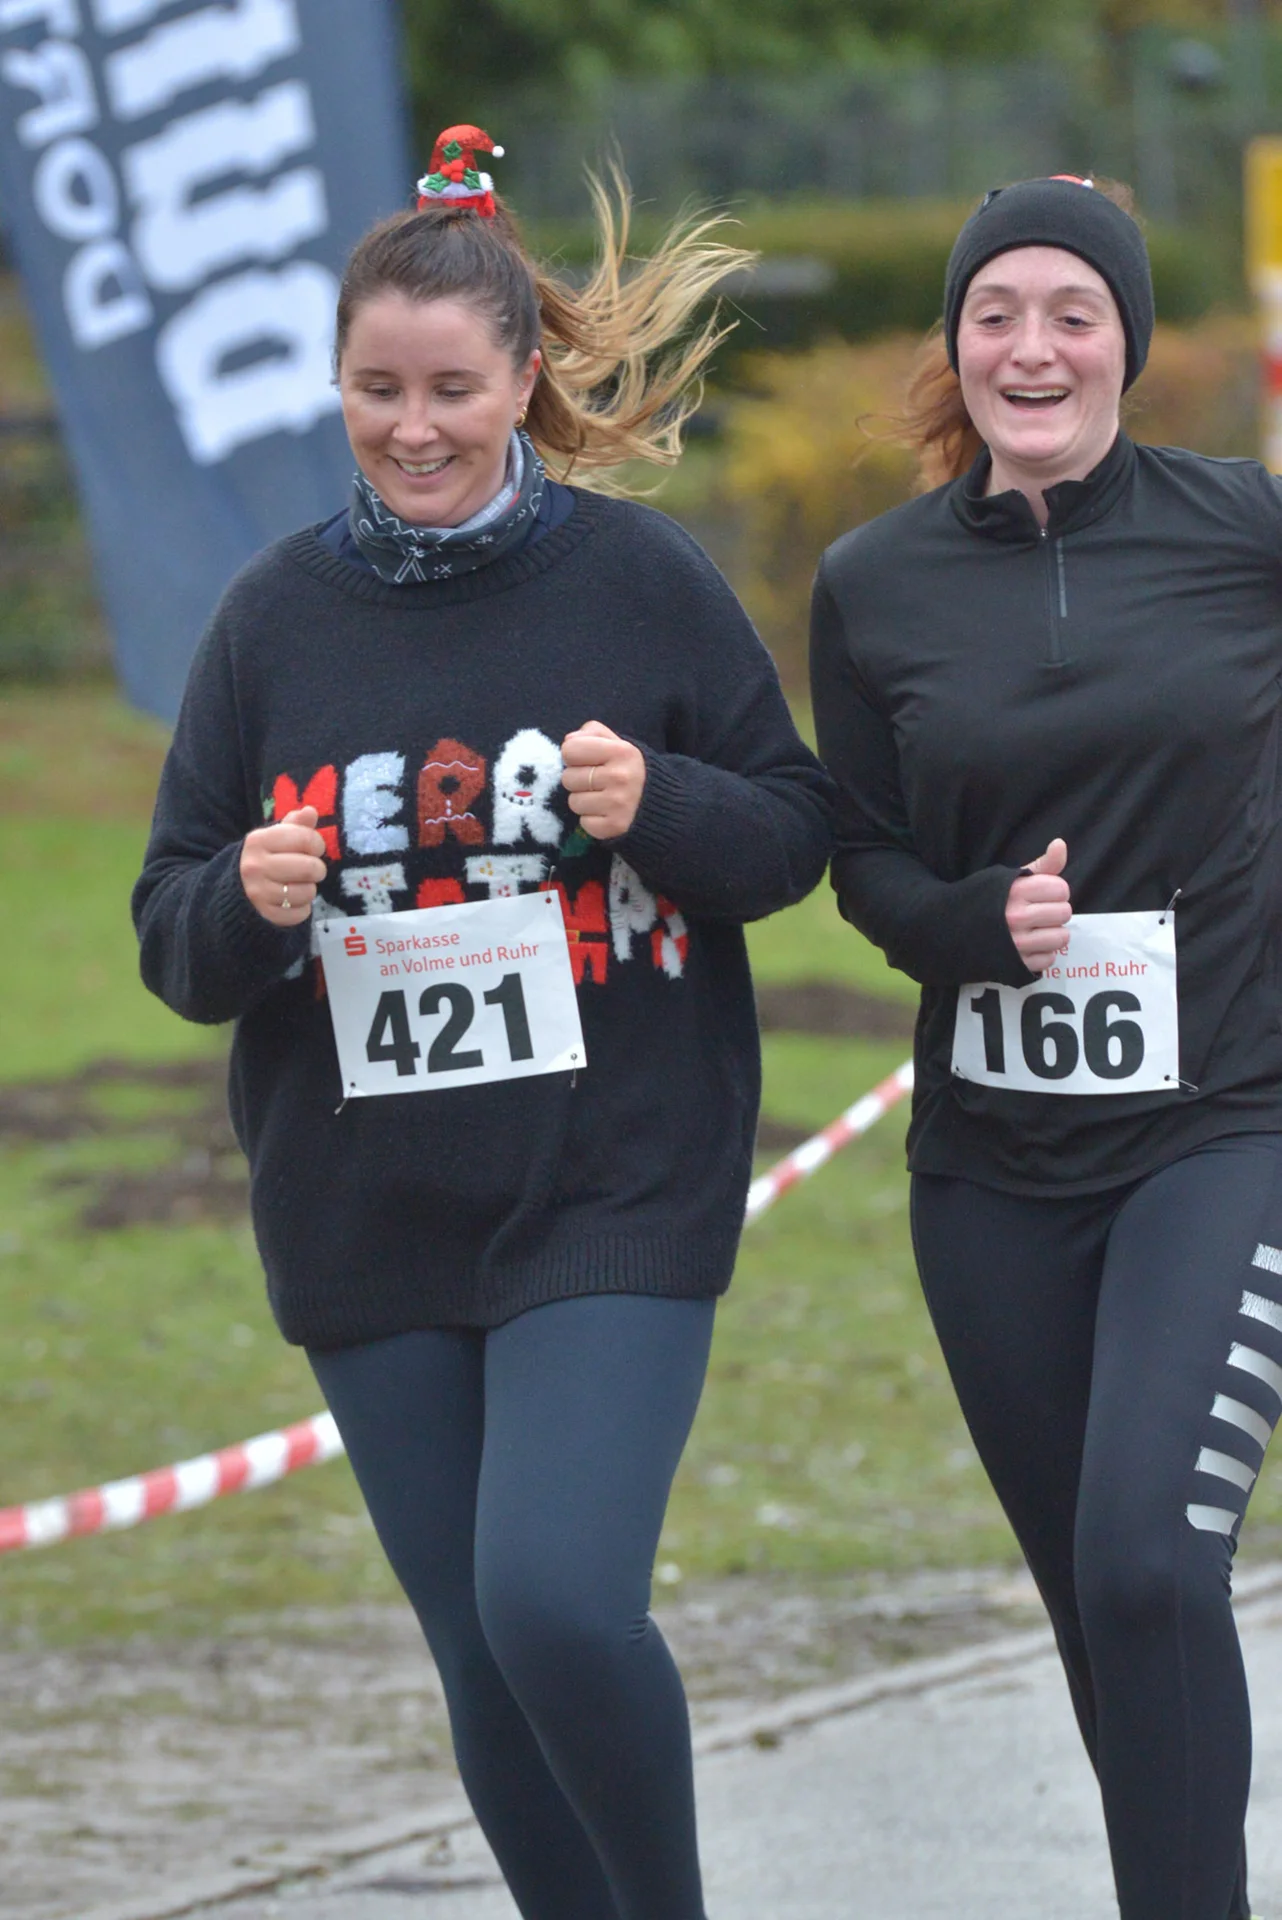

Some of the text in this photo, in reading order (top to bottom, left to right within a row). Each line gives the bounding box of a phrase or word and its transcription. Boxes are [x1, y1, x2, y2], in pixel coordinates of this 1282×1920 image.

[273, 728, 595, 860] MERR
[375, 932, 460, 956] Sparkasse
[380, 942, 539, 976] an Volme und Ruhr
[1066, 962, 1099, 979] und
[1105, 960, 1148, 978] Ruhr
[366, 973, 534, 1077] 421
[971, 988, 1145, 1080] 166
